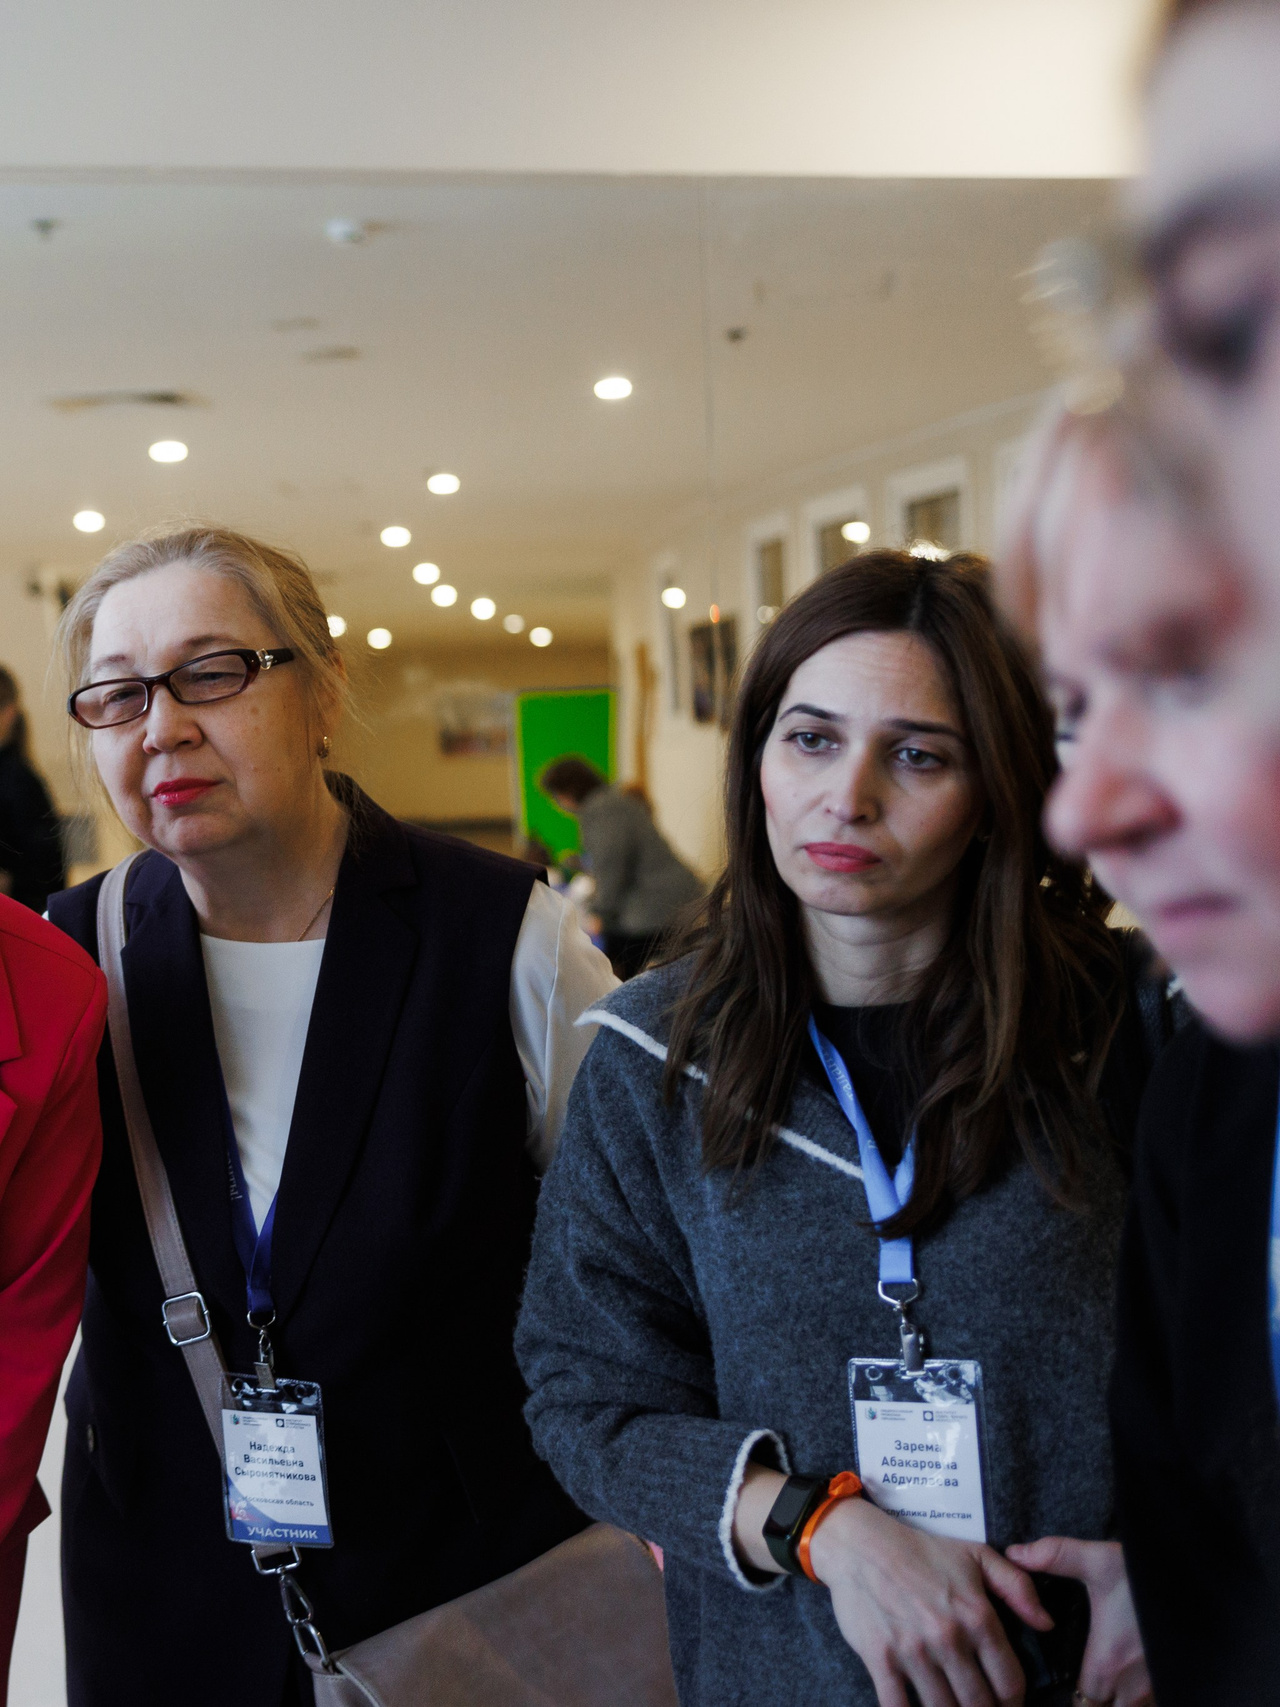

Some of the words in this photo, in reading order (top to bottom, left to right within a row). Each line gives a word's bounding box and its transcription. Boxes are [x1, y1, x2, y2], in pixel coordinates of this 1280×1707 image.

[249, 1441, 295, 1454] Надежда
[894, 1439, 942, 1453] Зарема
[243, 1454, 304, 1467] Васильевна
[234, 1466, 317, 1481] Сыромятникова
[286, 1498, 314, 1507] область
[883, 1508, 927, 1517] спублика
[929, 1509, 973, 1519] Дагестан
[247, 1526, 319, 1539] УЧАСТНИК
